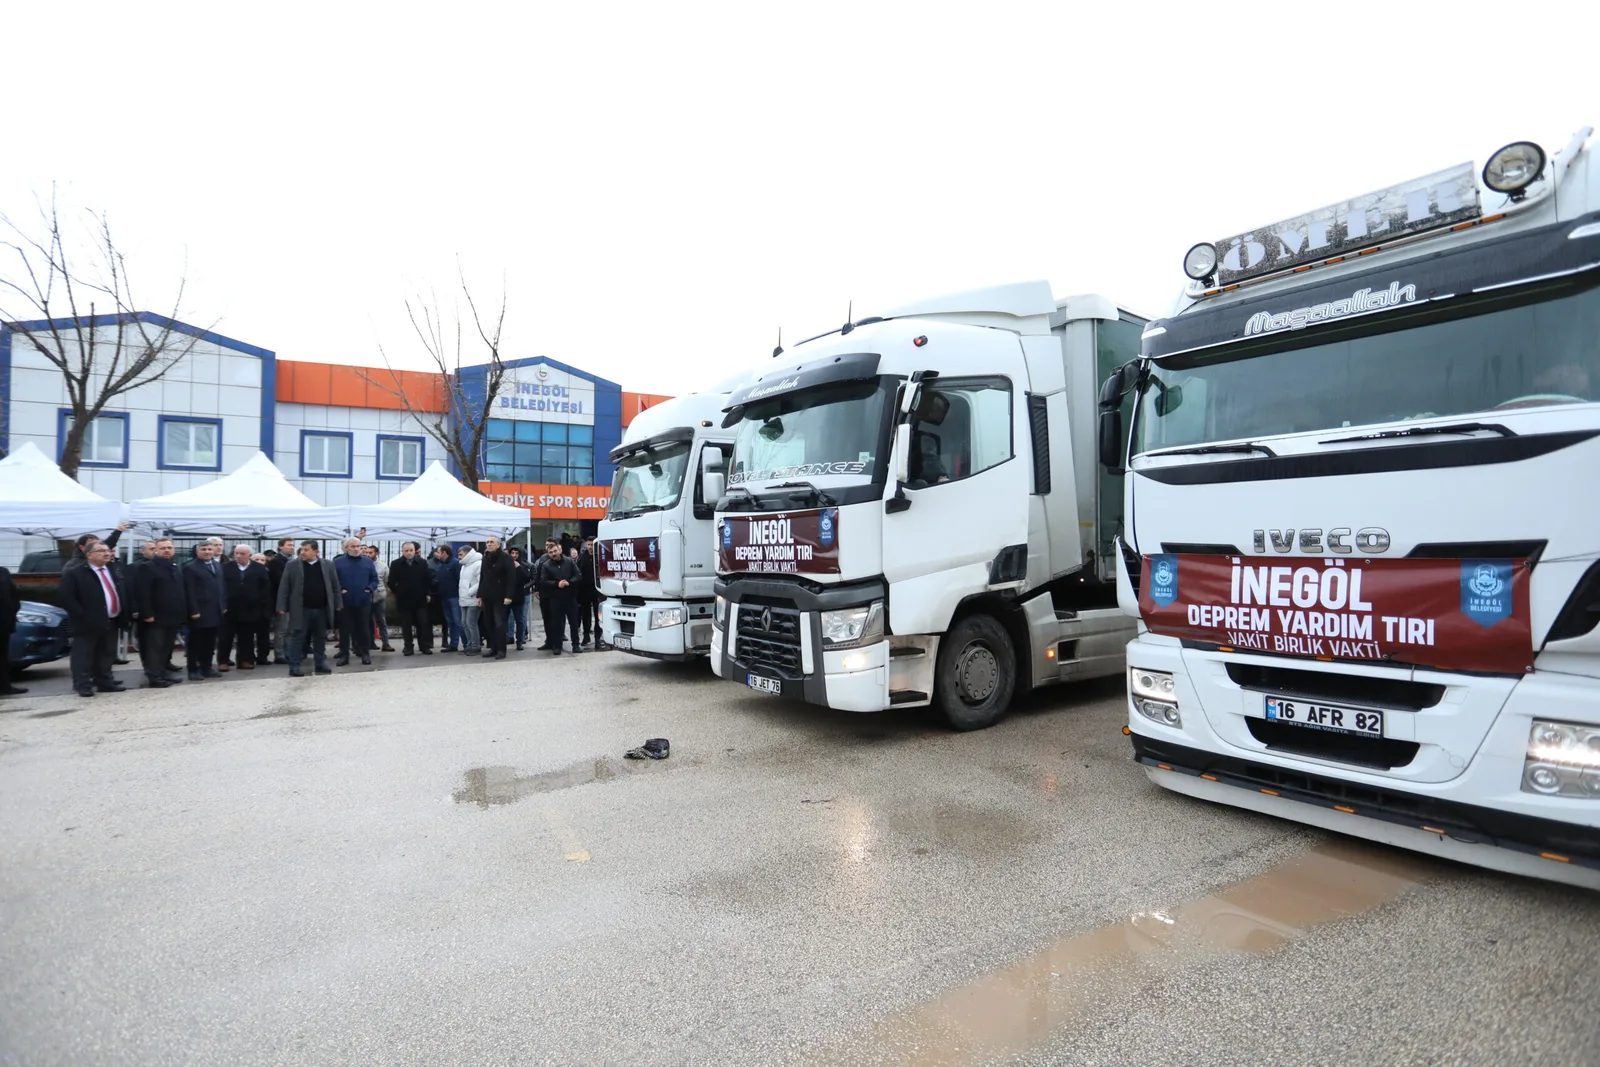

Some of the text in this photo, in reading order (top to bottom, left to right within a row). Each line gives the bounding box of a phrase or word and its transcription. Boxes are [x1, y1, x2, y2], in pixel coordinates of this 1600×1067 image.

[517, 383, 569, 398] İNEGÖL
[501, 397, 583, 414] BELEDİYESİ
[539, 496, 573, 508] SPOR
[749, 514, 794, 544] İNEGÖL
[613, 539, 636, 560] İNEGÖL
[1253, 527, 1391, 553] IVECO
[735, 545, 812, 560] DEPREM YARDIM TIRI
[763, 561, 780, 572] BİRLİK
[1231, 557, 1372, 611] İNEGÖL
[1187, 604, 1435, 646] DEPREM YARDIM TIRI
[1228, 631, 1381, 659] VAKİT BİRLİK VAKTİ
[759, 678, 770, 689] JET
[772, 681, 780, 692] 76
[1278, 702, 1295, 719] 16
[1307, 706, 1343, 727] AFR
[1355, 713, 1379, 732] 82
